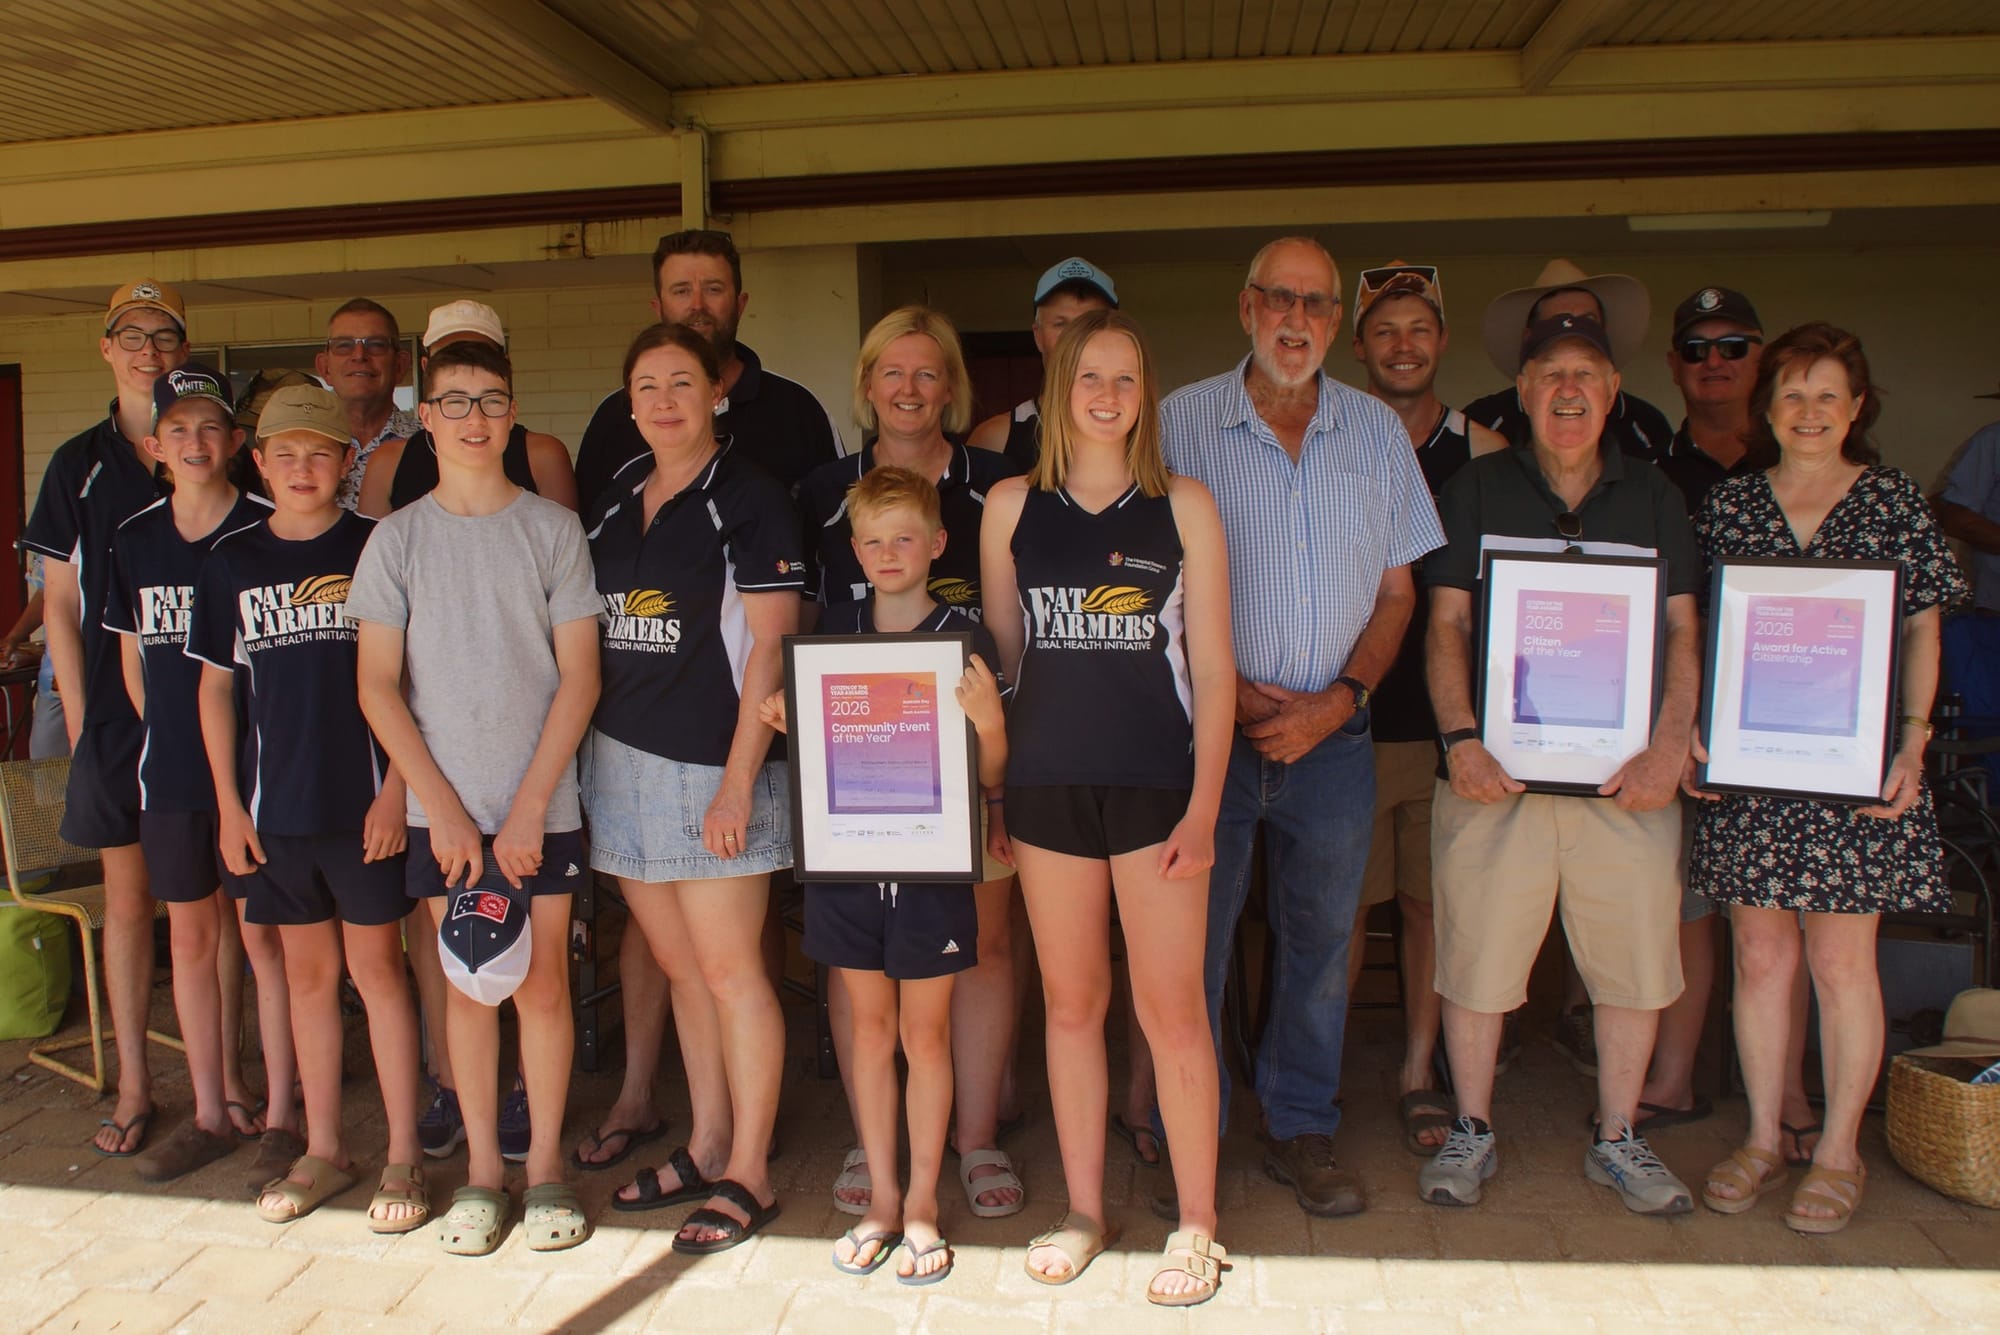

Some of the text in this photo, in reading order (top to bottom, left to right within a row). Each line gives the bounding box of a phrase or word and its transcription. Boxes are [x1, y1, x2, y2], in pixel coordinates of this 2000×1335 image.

[139, 586, 194, 628] FAT
[239, 583, 294, 629] FAT
[600, 592, 626, 616] AT
[1028, 587, 1087, 629] FAT
[603, 614, 681, 643] ARMERS
[1028, 607, 1156, 640] FARMERS
[1525, 615, 1563, 630] 2026
[1754, 621, 1794, 636] 2026
[143, 635, 169, 646] RURAL
[246, 628, 358, 653] RURAL HEALTH INITIATIV
[632, 642, 677, 654] INITIATIVE
[1063, 640, 1101, 650] HEALTH
[1104, 641, 1151, 651] INITIATIVE
[1523, 636, 1561, 647] Citizen
[1522, 646, 1582, 657] of the Year
[1752, 642, 1848, 655] Award for Active
[1752, 652, 1813, 668] Citizenship
[831, 701, 870, 716] 2026
[831, 722, 931, 735] Community Event
[832, 733, 891, 743] of the Year
